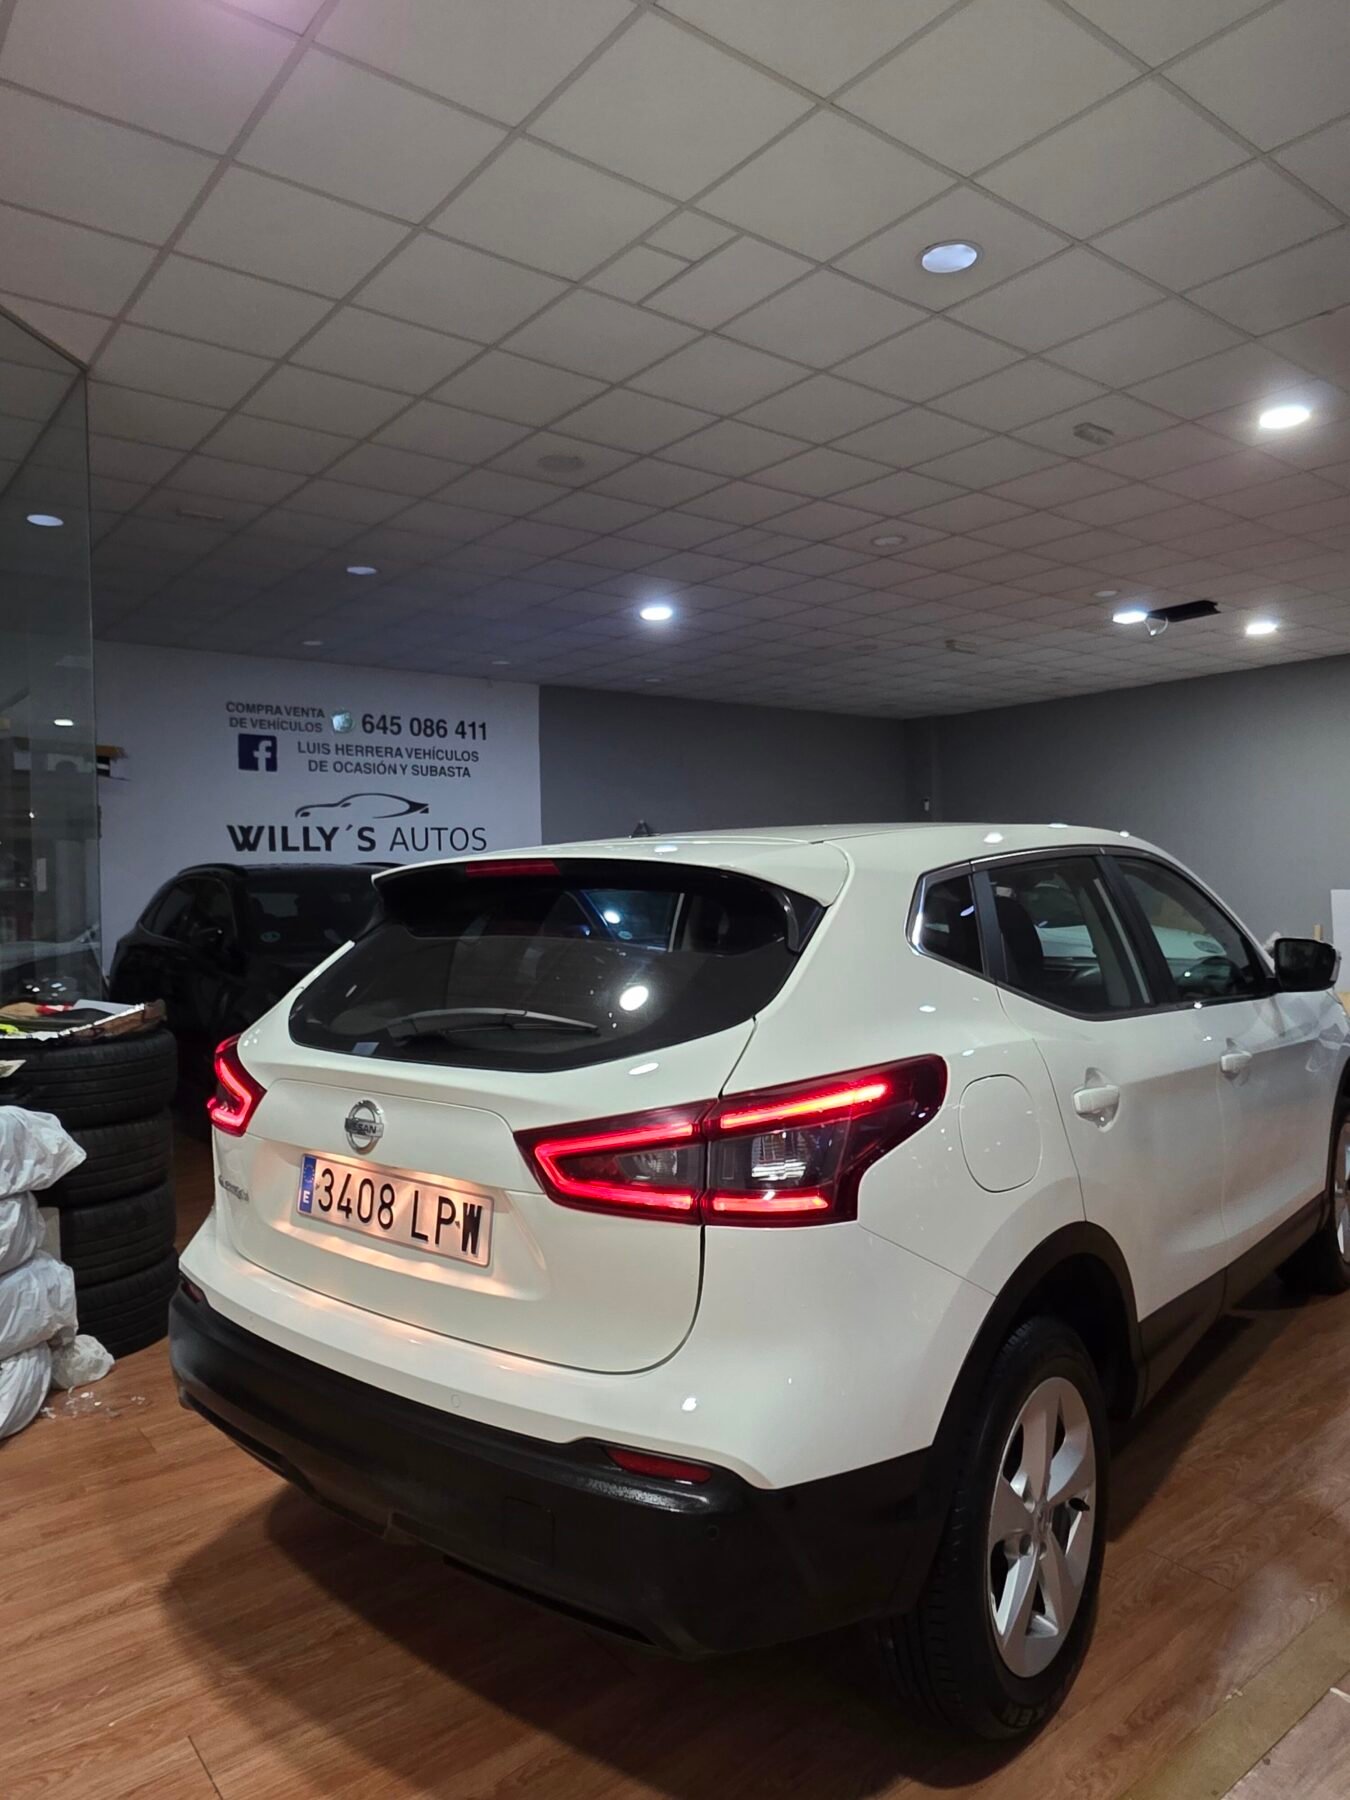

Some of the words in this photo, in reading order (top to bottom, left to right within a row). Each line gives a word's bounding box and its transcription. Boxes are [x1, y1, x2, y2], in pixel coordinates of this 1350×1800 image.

[226, 702, 283, 715] COMPRA
[284, 706, 325, 718] VENTA
[229, 717, 248, 729] DE
[250, 717, 323, 733] VEHÍCULOS
[361, 713, 401, 735] 645
[409, 717, 448, 738] 086
[454, 720, 487, 741] 411
[297, 741, 331, 755] LUIS
[335, 743, 403, 759] HERRERA
[405, 746, 479, 762] VEHÍCULOS
[308, 759, 328, 772] DE
[333, 760, 397, 775] OCASIÓN
[400, 764, 408, 776] Y
[411, 764, 471, 778] SUBASTA
[389, 826, 487, 851] AUTOS
[302, 1190, 310, 1204] E
[318, 1168, 395, 1230] 3408
[411, 1190, 483, 1254] LPW
